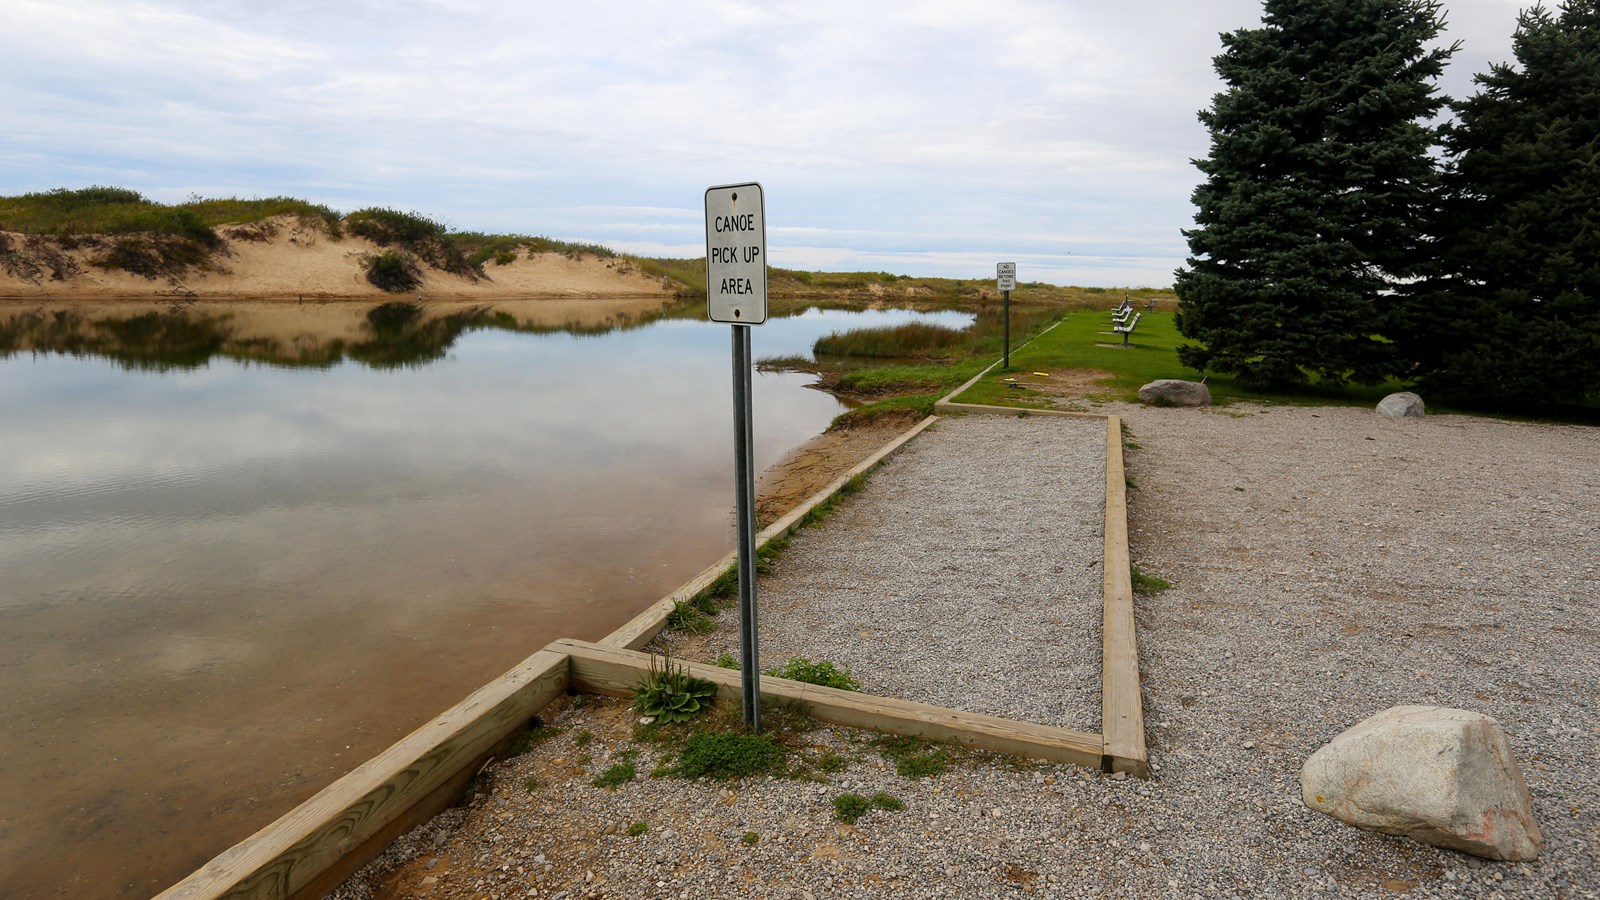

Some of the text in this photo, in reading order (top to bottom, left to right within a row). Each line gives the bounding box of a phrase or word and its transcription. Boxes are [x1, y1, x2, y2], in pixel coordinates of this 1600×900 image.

[715, 214, 755, 233] CANOE
[712, 246, 760, 264] PICK UP
[720, 278, 753, 294] AREA
